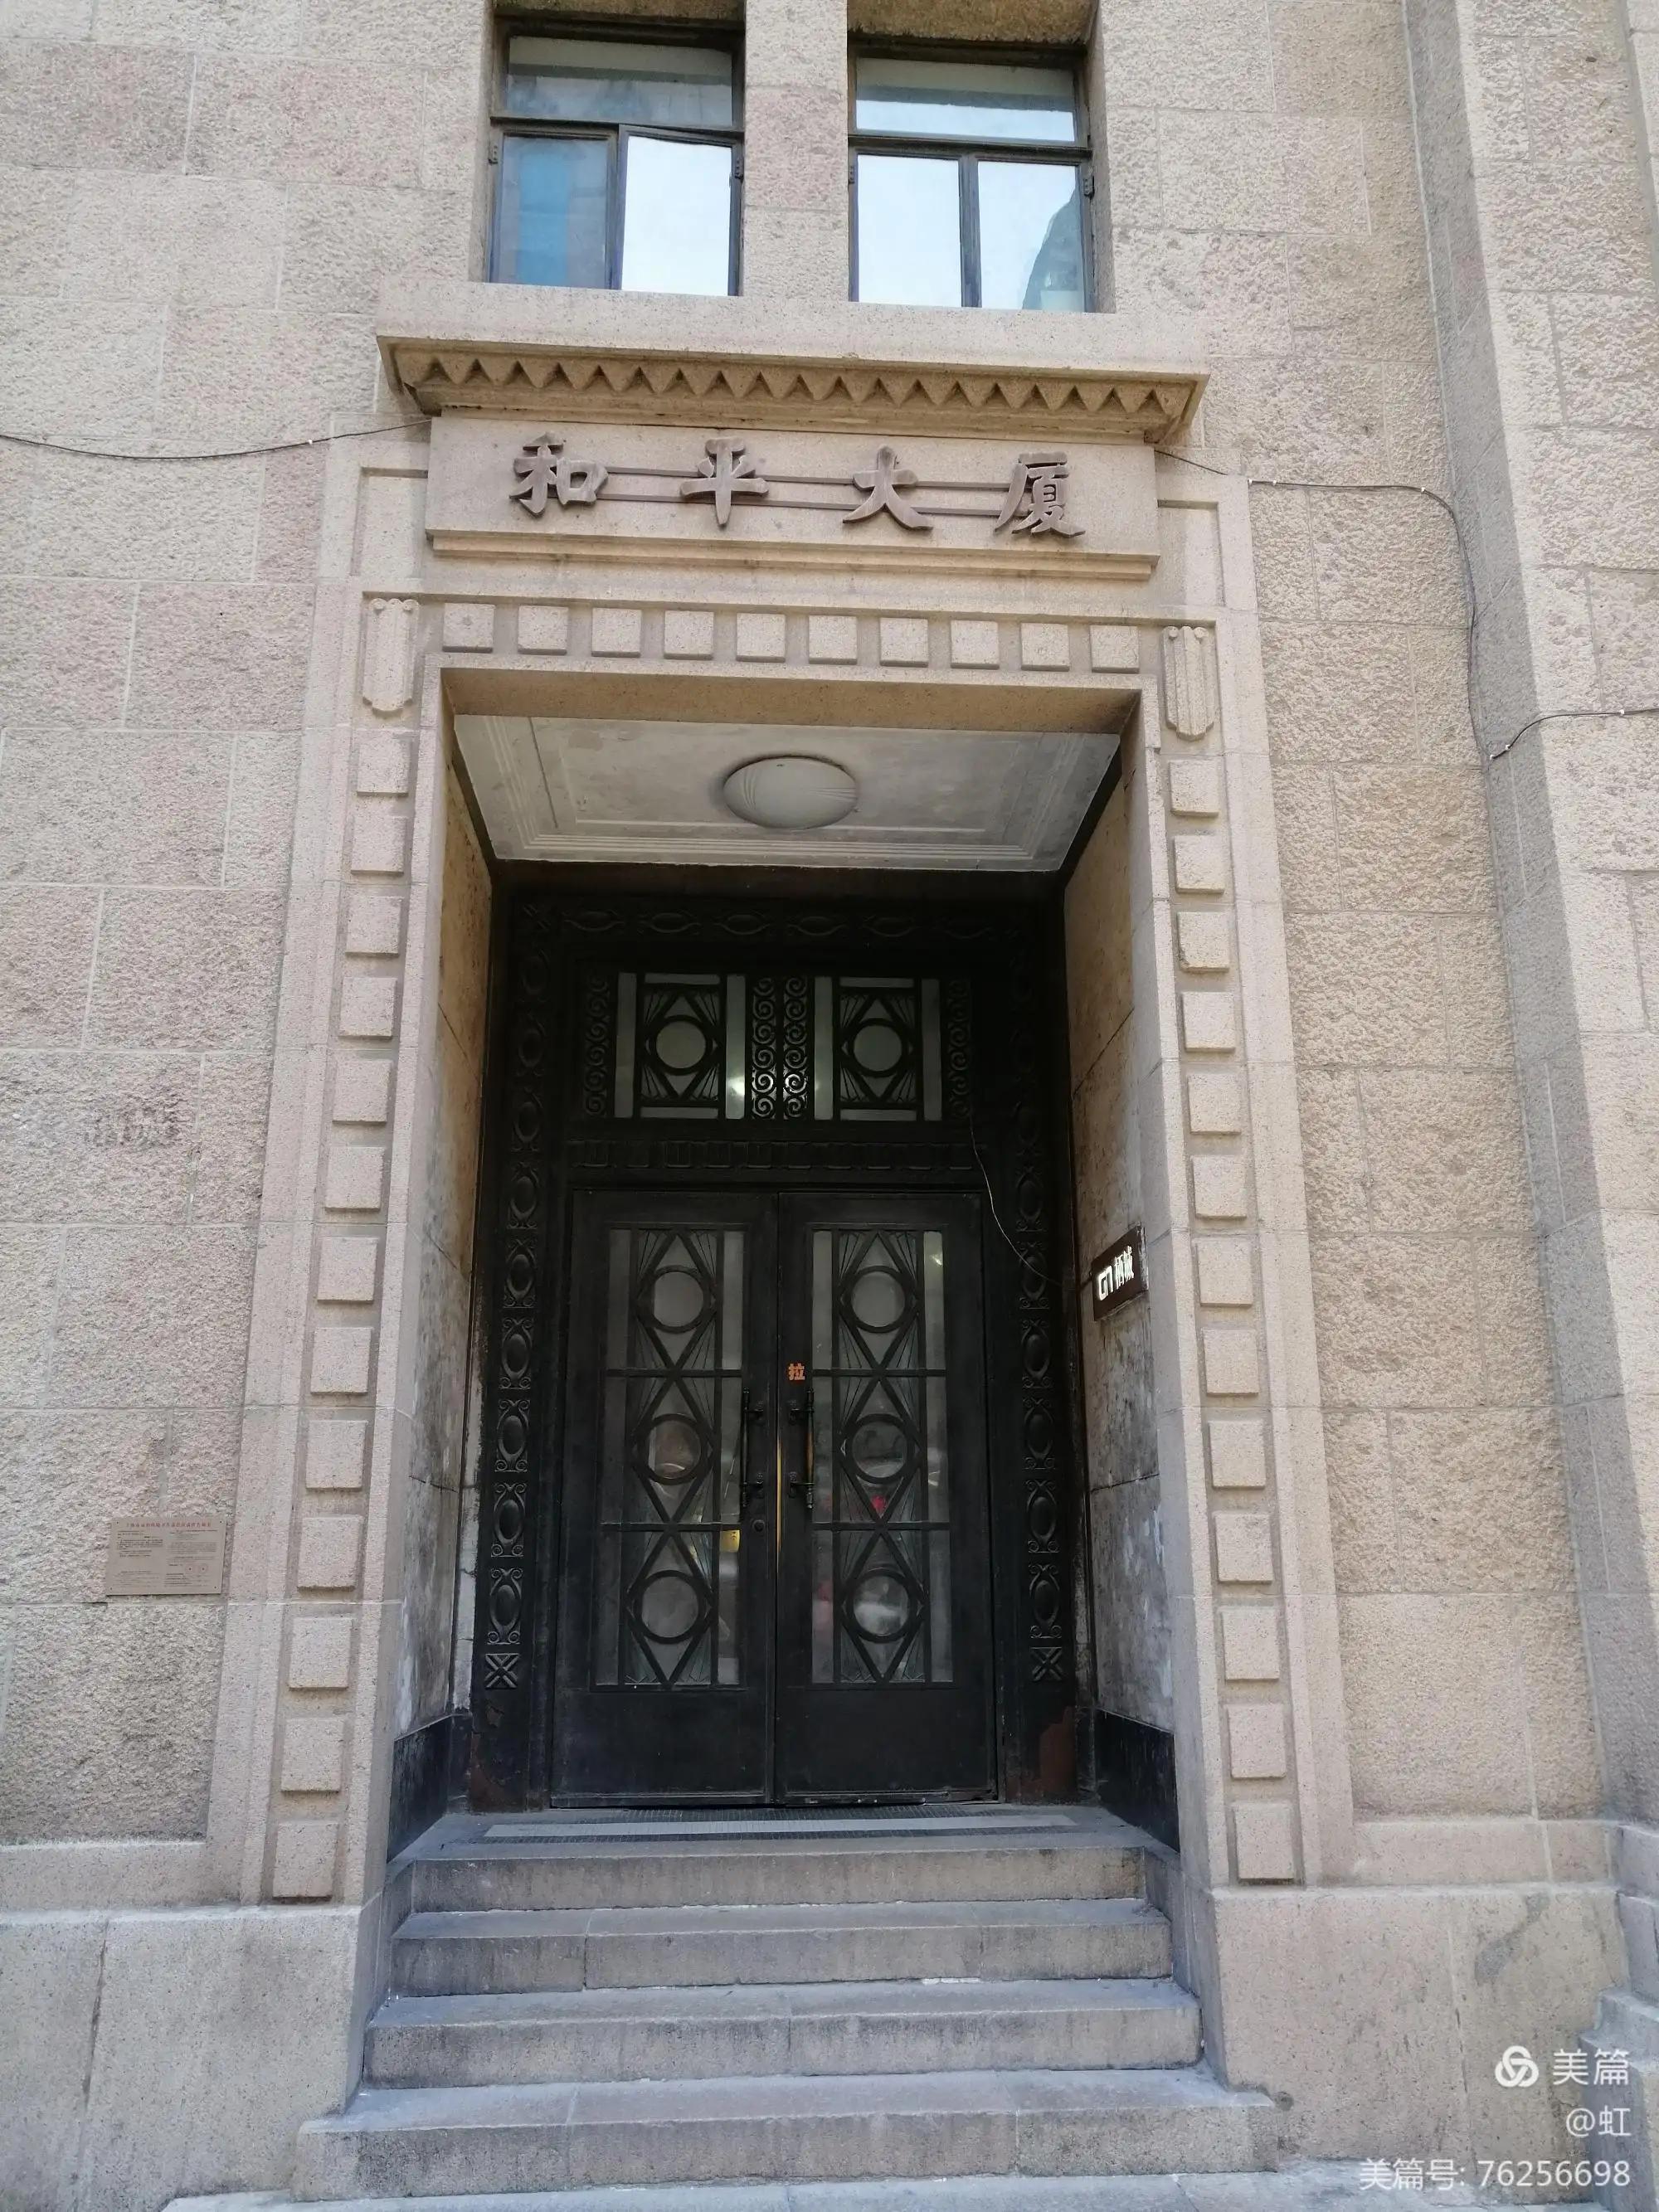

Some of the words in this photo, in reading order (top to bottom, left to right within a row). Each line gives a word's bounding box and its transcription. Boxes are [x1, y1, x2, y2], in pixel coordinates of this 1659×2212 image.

[509, 432, 1085, 537] 和平大厦
[788, 1363, 805, 1380] 拉
